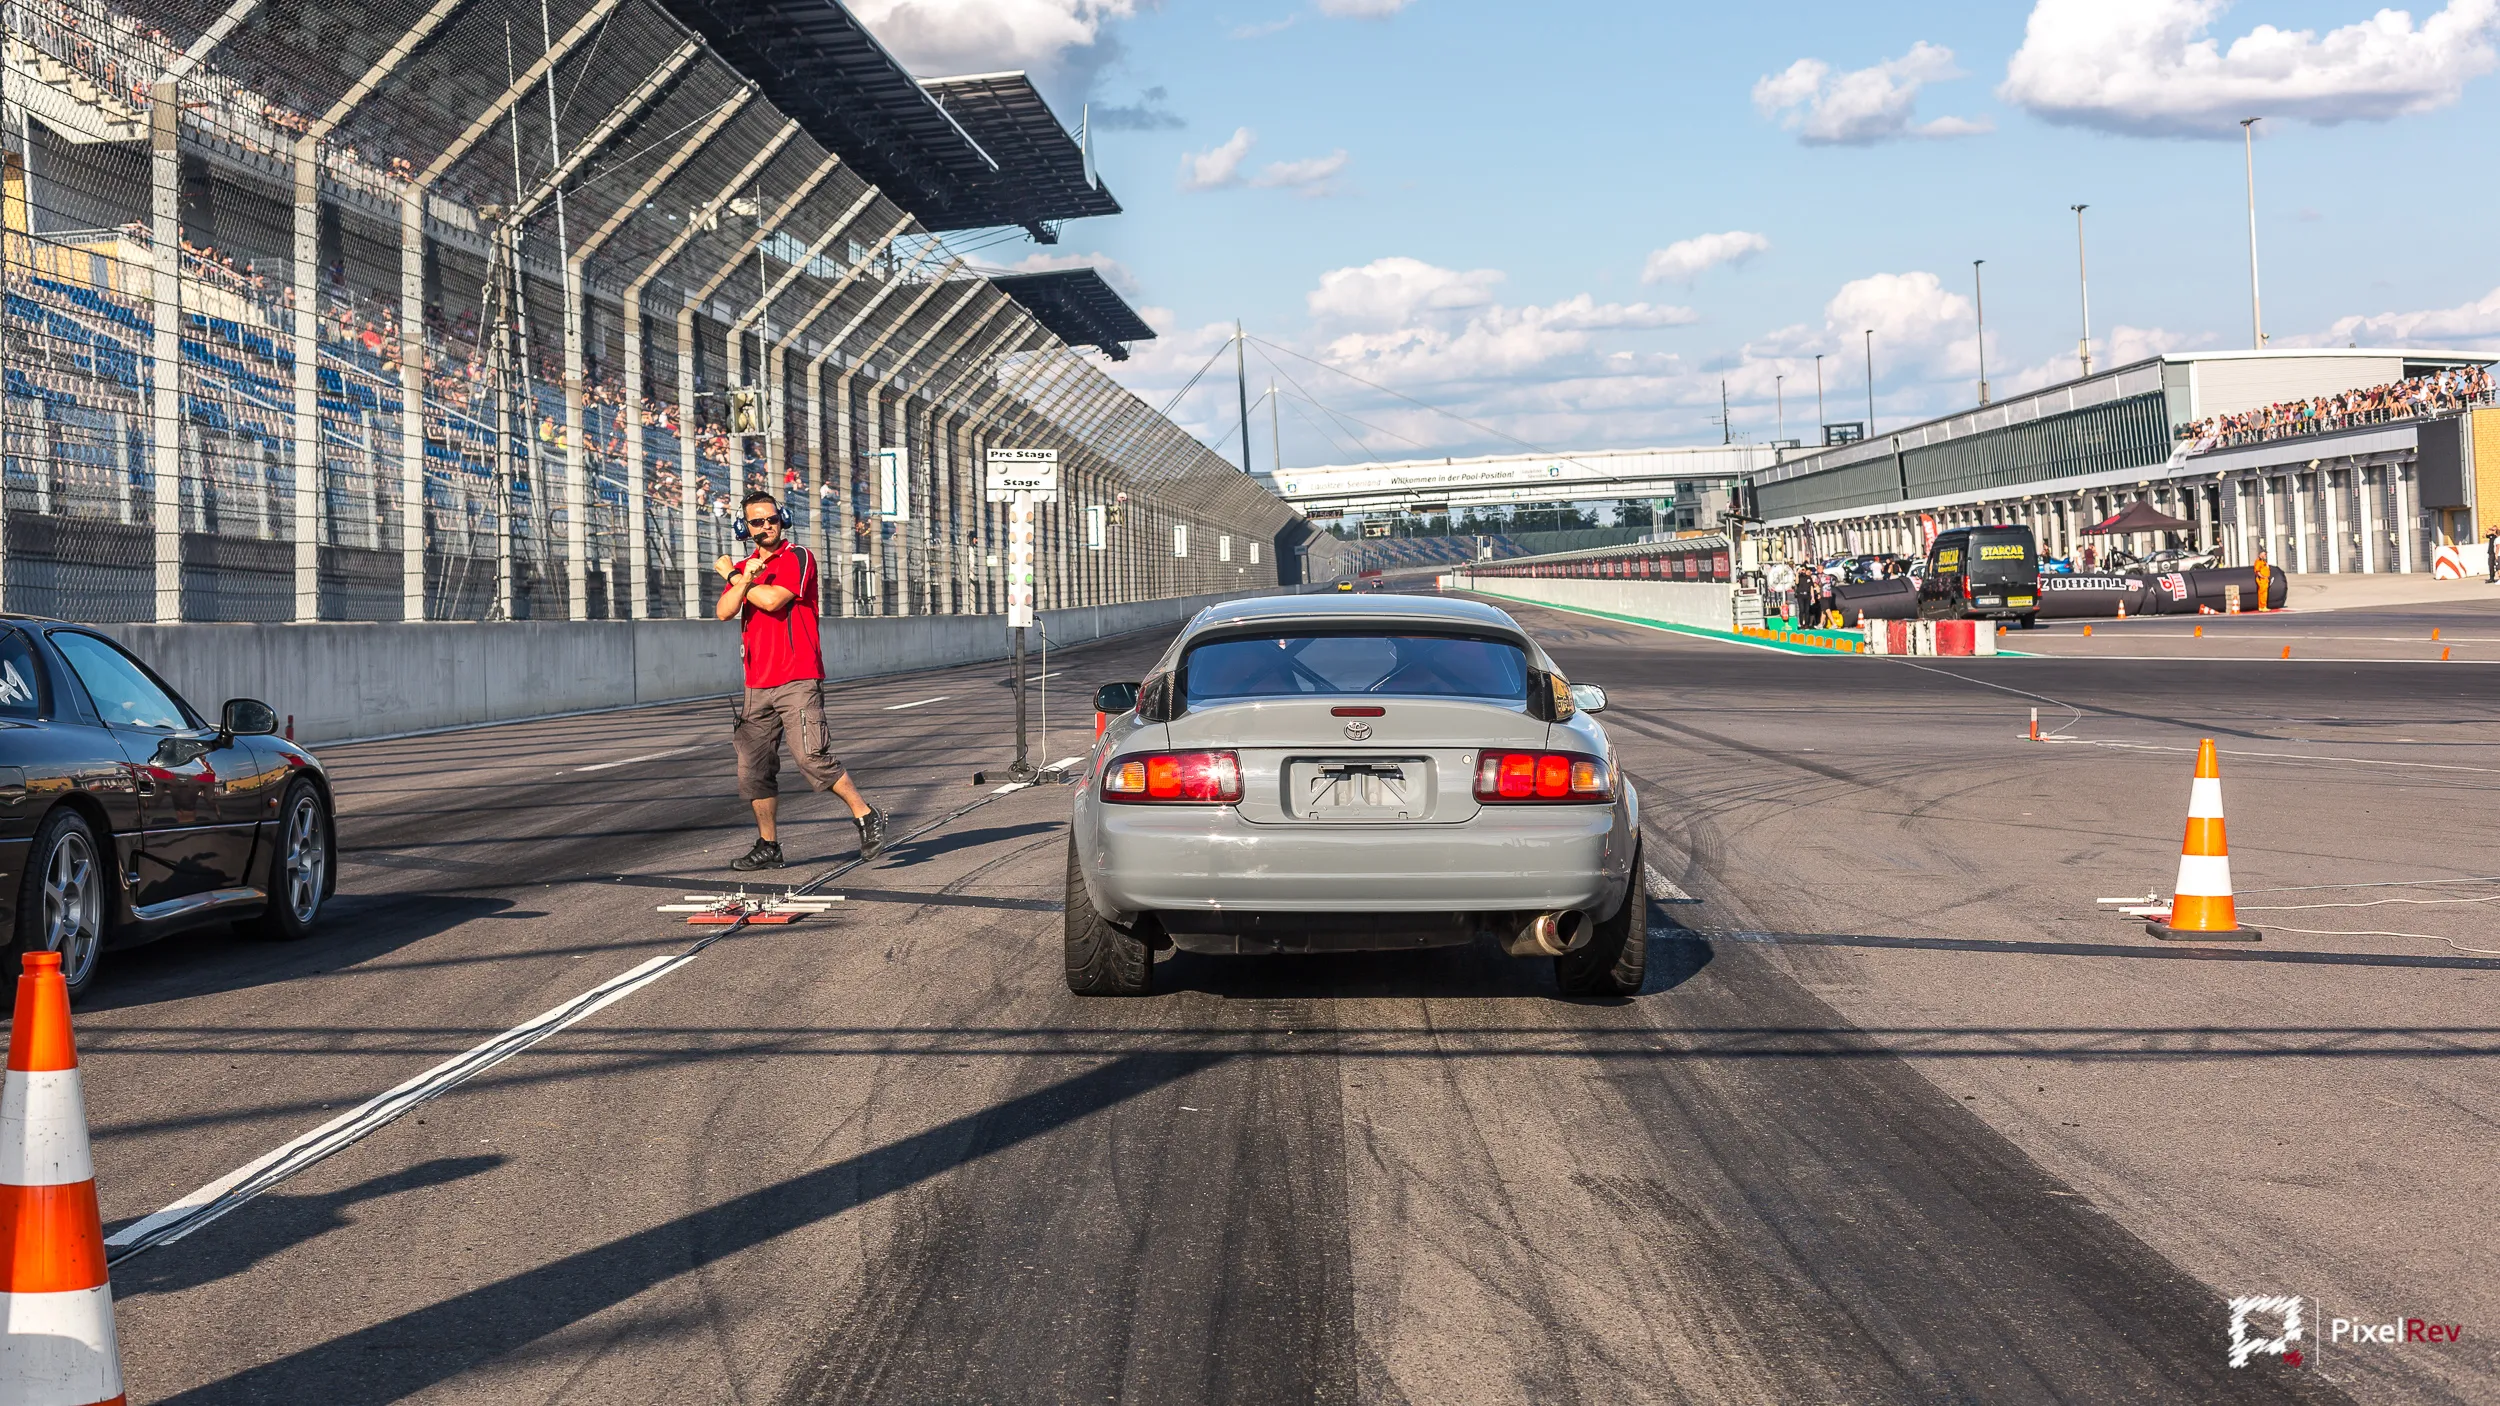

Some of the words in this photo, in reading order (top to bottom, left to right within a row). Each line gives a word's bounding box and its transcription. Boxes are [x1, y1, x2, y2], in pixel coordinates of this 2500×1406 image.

[1016, 451, 1052, 459] Stage
[1391, 475, 1437, 485] Willkommen
[1438, 474, 1446, 482] in
[1447, 473, 1460, 482] der
[1461, 470, 1515, 481] Pool-Position!
[1003, 479, 1041, 487] Stage
[1980, 545, 2025, 556] STARCAR
